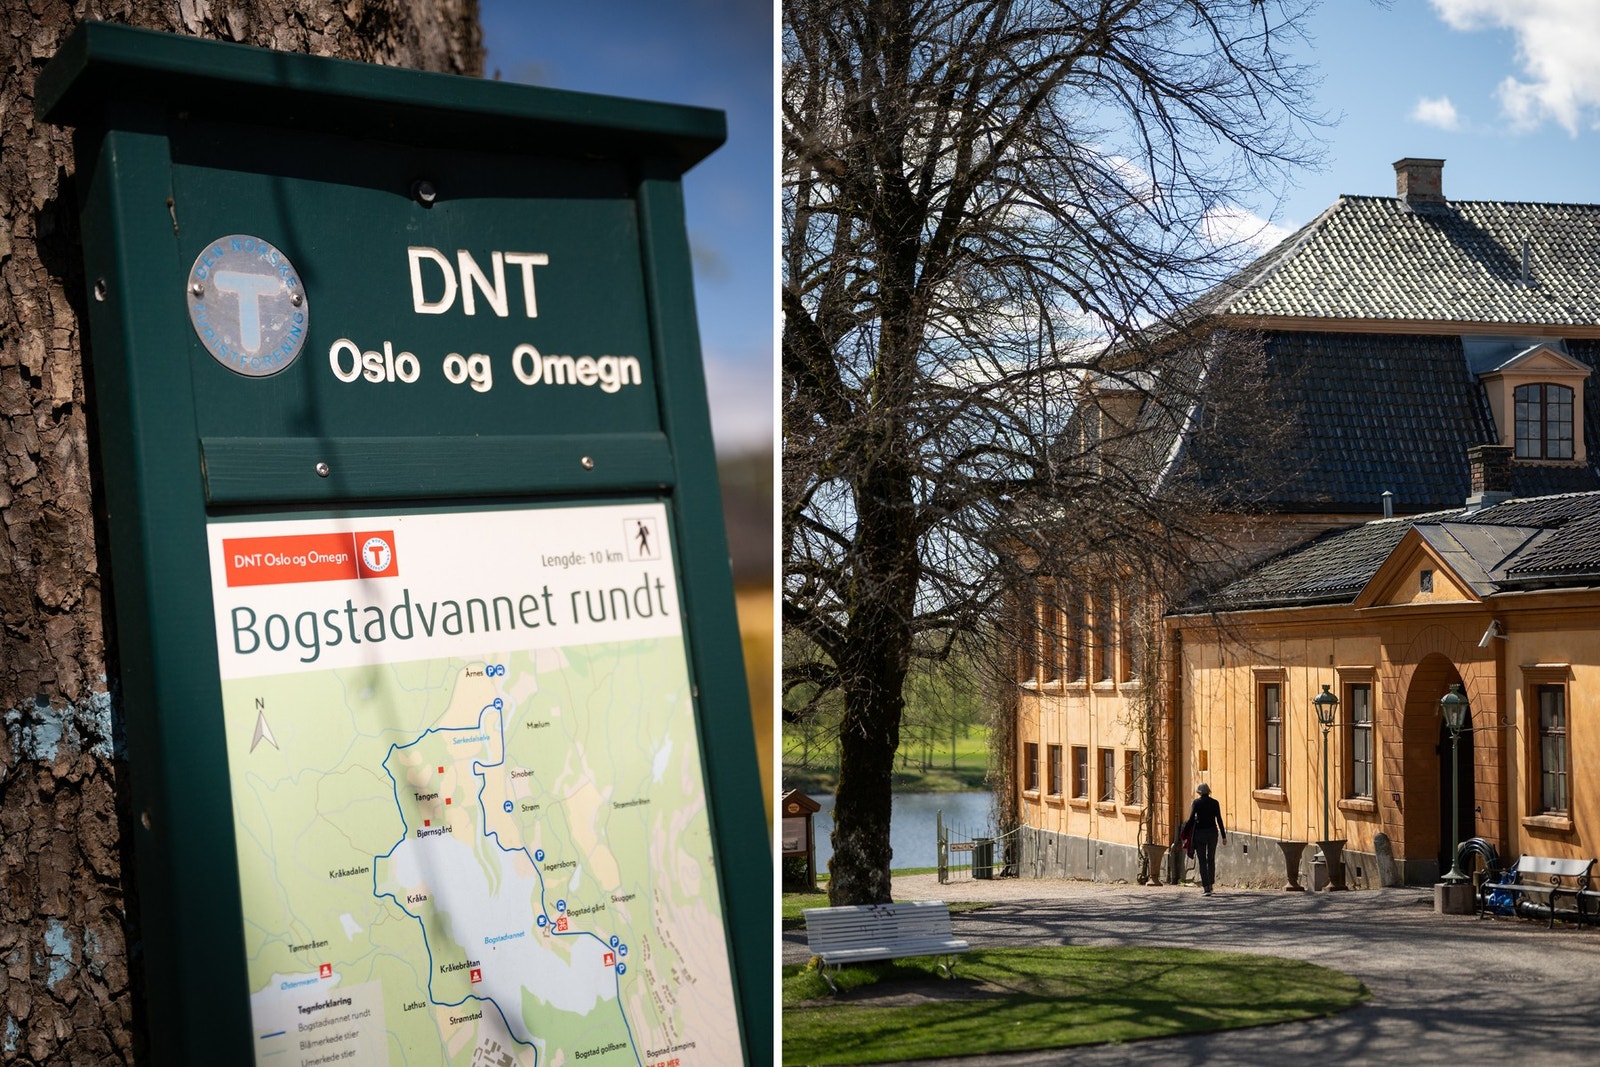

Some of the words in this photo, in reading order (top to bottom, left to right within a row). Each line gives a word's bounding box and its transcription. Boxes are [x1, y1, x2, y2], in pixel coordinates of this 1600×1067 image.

[194, 245, 224, 281] DEN
[231, 239, 298, 289] NORSKE
[408, 246, 549, 318] DNT
[193, 304, 304, 371] TURISTFORENING
[329, 338, 421, 383] Oslo
[443, 353, 493, 393] og
[512, 343, 642, 393] Omegn
[234, 554, 262, 568] DNT
[264, 552, 291, 566] Oslo
[293, 554, 306, 566] og
[308, 550, 348, 565] Omegn
[542, 553, 586, 569] Lengde:
[590, 552, 603, 564] 10
[606, 550, 624, 563] km
[231, 585, 557, 663] Bogstadvannet
[571, 572, 669, 624] rundt
[466, 668, 484, 678] Årnes
[255, 697, 264, 710] N
[511, 770, 534, 779] Sinober
[414, 792, 438, 801] Tangen
[522, 804, 540, 812] Strøm
[416, 825, 452, 838] Bjørnsgård
[329, 866, 370, 878] Kråkadalen
[544, 860, 576, 872] Jegersborg
[407, 894, 428, 904] Kråka
[610, 894, 636, 904] Skuggen
[567, 907, 590, 918] Bogstad
[592, 903, 606, 914] gård
[440, 960, 480, 974] Kråkebråtan
[298, 998, 352, 1014] Tegnforklaring
[403, 1001, 426, 1012] Lathus
[298, 1014, 351, 1032] Bogstadvannet
[449, 1010, 483, 1025] Strømstad
[300, 1034, 343, 1050] Blåmerkede
[575, 1046, 600, 1060] Bogstad
[646, 1046, 670, 1058] Bogstad
[671, 1042, 696, 1052] camping
